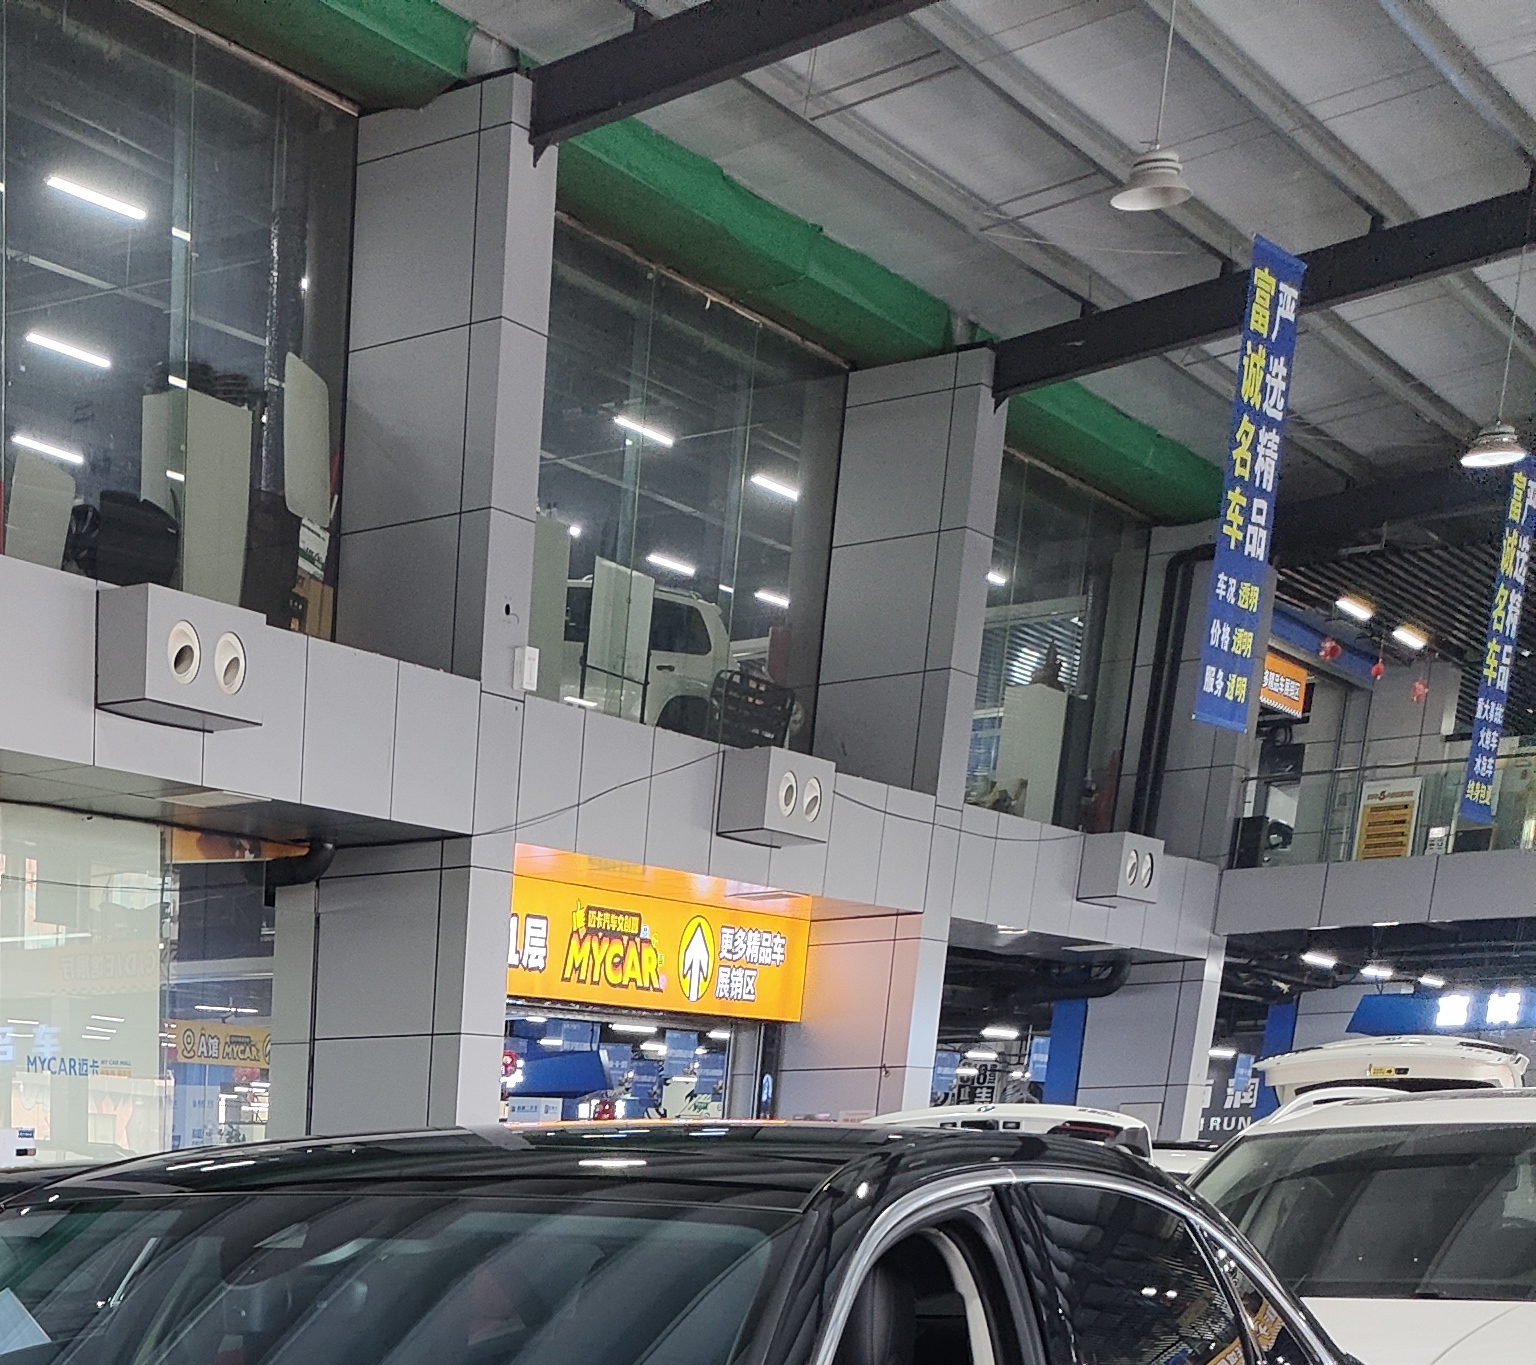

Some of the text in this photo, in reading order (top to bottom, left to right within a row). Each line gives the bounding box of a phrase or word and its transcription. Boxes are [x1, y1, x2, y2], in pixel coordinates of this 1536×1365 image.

[1222, 266, 1277, 550] 富诚名车
[1243, 280, 1299, 561] 严选精品
[561, 932, 664, 992] MYCAR
[719, 925, 787, 967] 更多精品车
[715, 966, 759, 1002] 展销区
[26, 1055, 100, 1077] MYCAR迈卡
[222, 1041, 261, 1061] MYCAR
